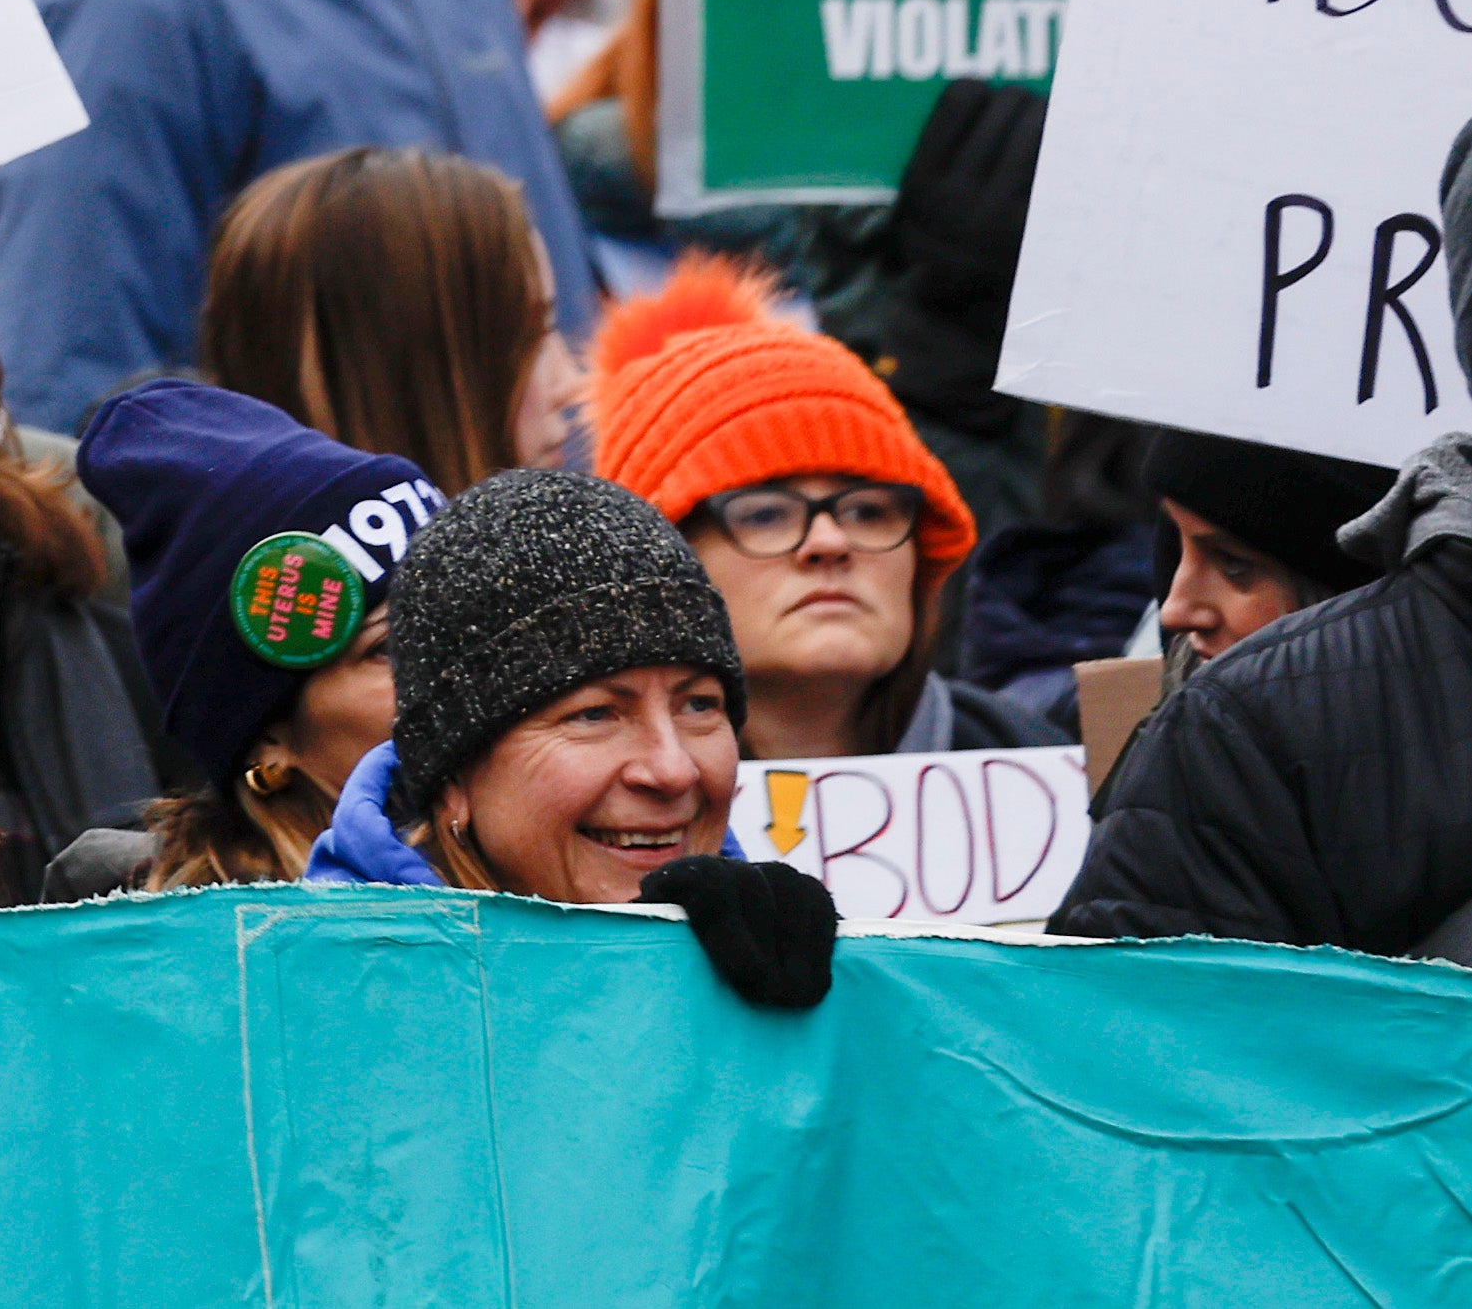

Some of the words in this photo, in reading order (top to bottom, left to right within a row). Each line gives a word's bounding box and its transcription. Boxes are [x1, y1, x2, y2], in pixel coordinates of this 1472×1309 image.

[250, 566, 279, 616] THIS
[267, 553, 306, 642] UTERUS
[296, 593, 318, 615] IS
[311, 578, 344, 639] MINE
[812, 750, 1086, 919] BOD
